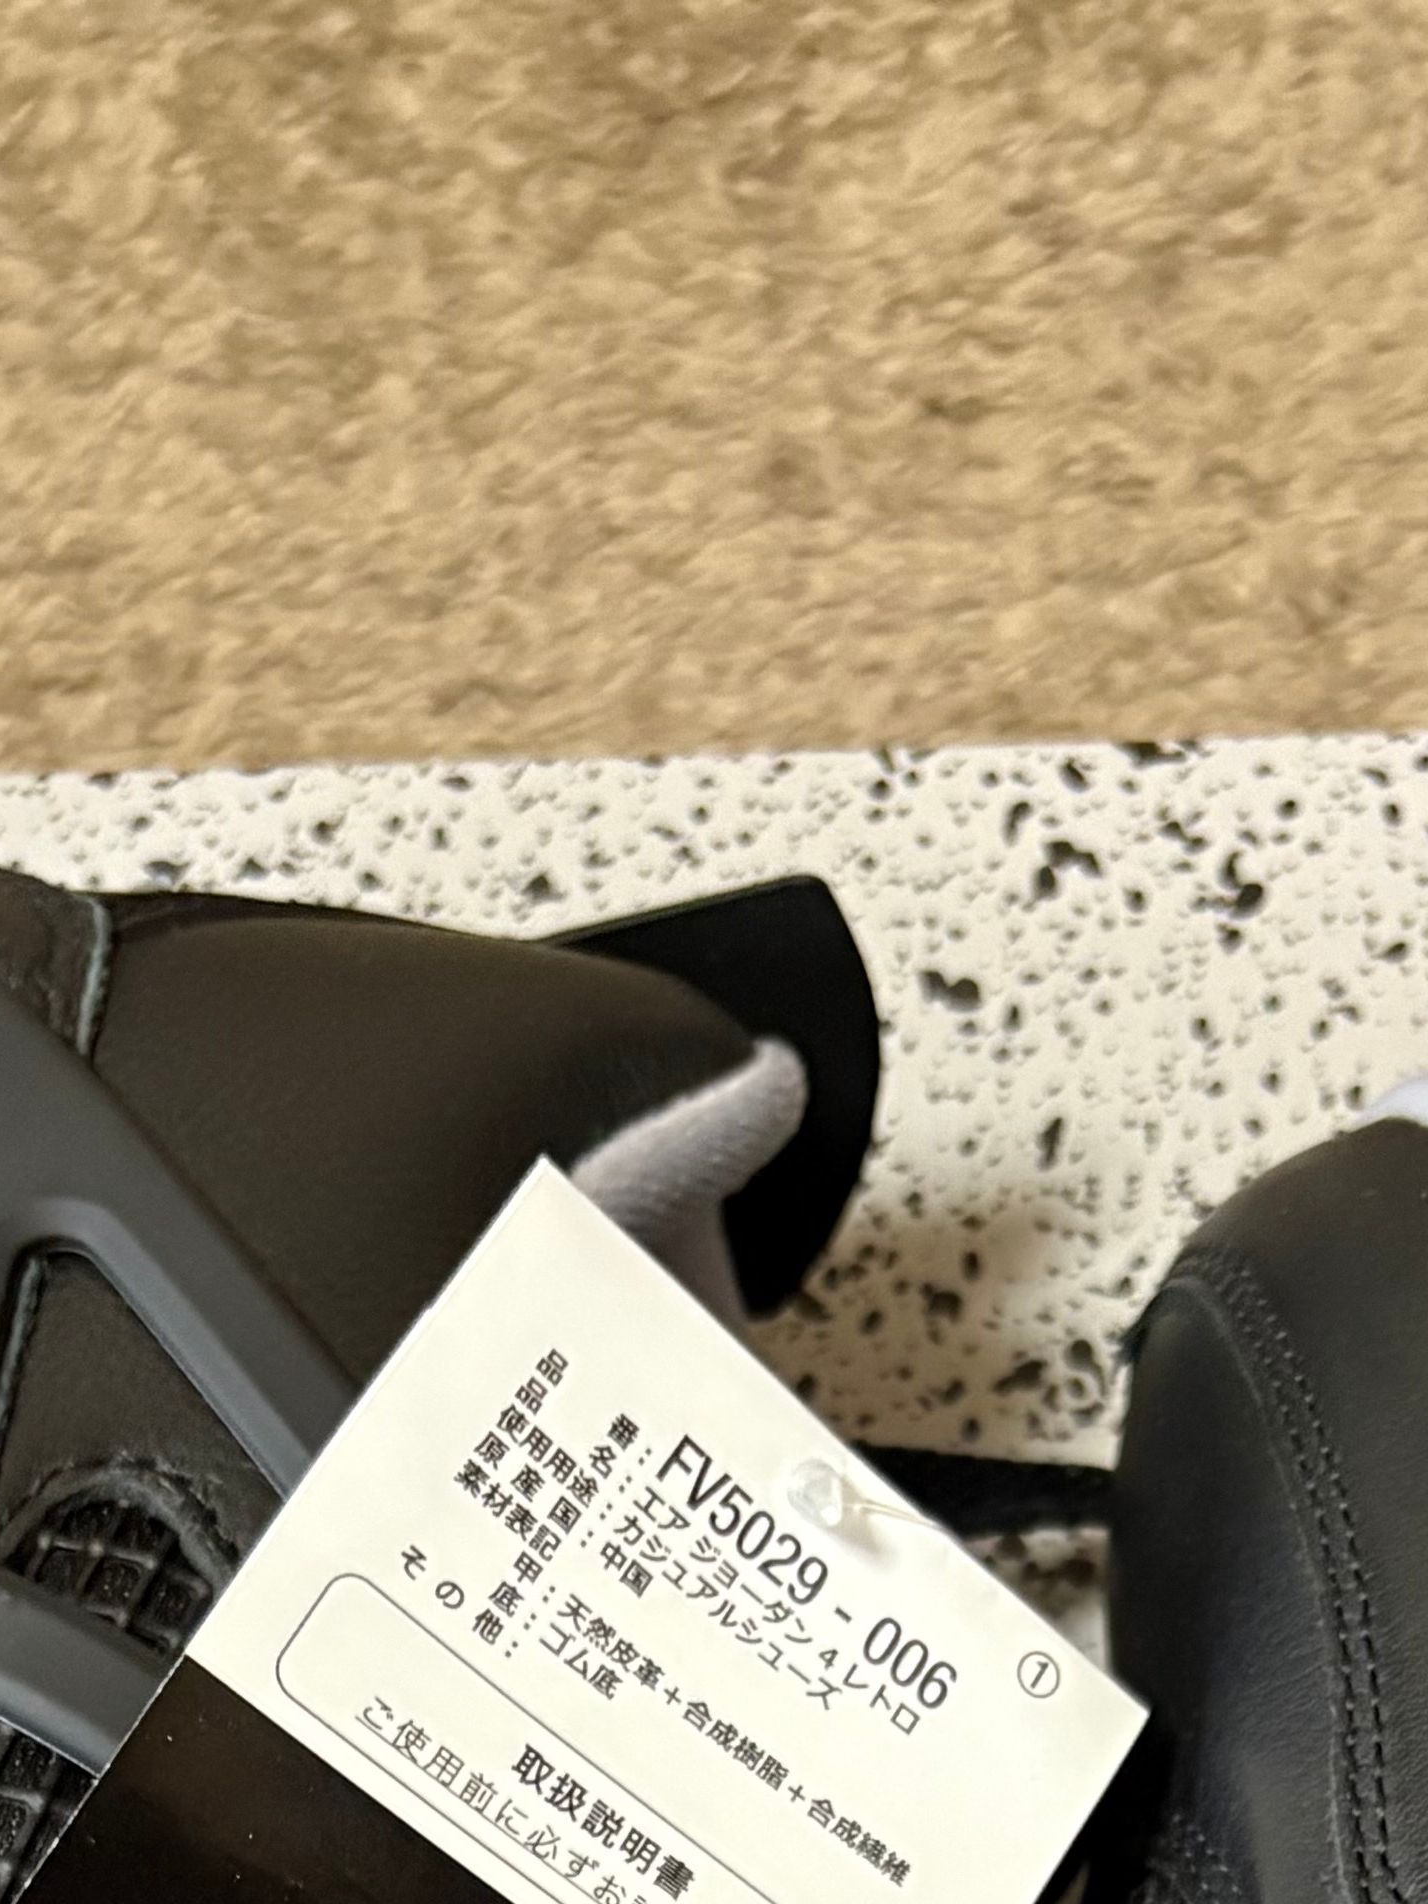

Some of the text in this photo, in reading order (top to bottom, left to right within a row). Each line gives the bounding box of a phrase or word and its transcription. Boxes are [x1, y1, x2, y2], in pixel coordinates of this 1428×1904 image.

[453, 1458, 563, 1563] 素材表記
[599, 1540, 654, 1599] 中国
[655, 1433, 829, 1606] FV5029
[862, 1616, 958, 1710] 006
[538, 1622, 624, 1701] ゴム底
[632, 1485, 692, 1531] エア
[688, 1535, 813, 1644] ジョーダン
[818, 1648, 839, 1671] 4
[842, 1663, 921, 1736] レトロ
[510, 1743, 695, 1902] 取扱説明書
